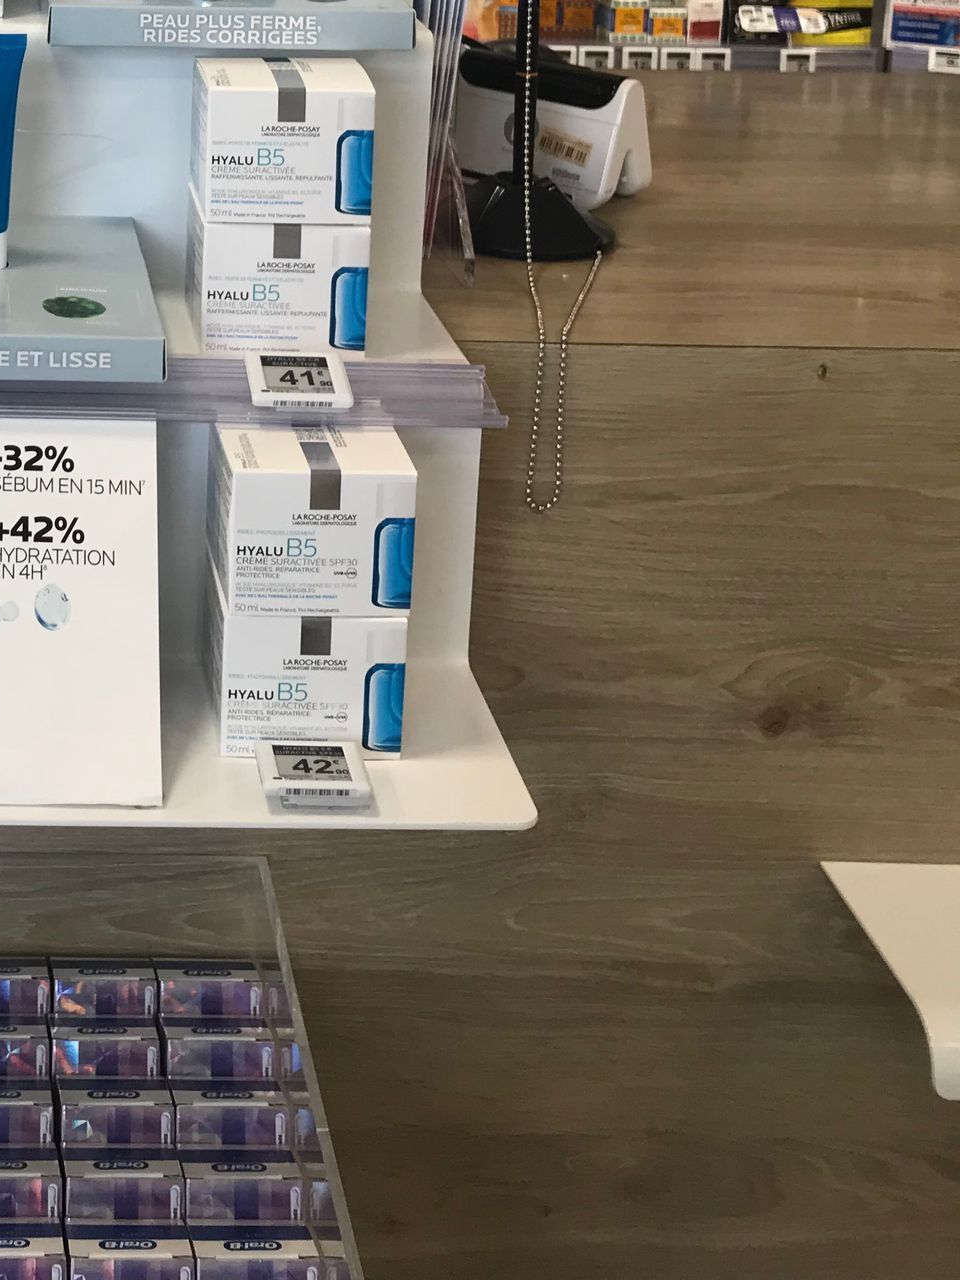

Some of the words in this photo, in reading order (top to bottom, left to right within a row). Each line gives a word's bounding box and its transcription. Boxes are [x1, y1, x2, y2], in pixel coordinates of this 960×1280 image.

[140, 13, 190, 28] PEAU
[195, 14, 246, 29] PLUS
[251, 15, 322, 33] FERME,
[143, 29, 201, 44] RIDES
[208, 26, 318, 45] CORRIGÉES
[211, 155, 254, 166] HYALU
[256, 148, 285, 166] B5
[207, 290, 249, 301] HYALU
[252, 283, 280, 302] B5
[16, 351, 44, 367] ET
[49, 352, 112, 368] LISSE
[58, 477, 83, 494] EN
[86, 478, 104, 495] 15
[292, 513, 302, 521] LA
[303, 513, 357, 521] ROCHE-POSAY
[236, 545, 284, 557] HYALU
[286, 537, 317, 557] B5
[235, 555, 268, 566] CRÈME
[270, 555, 328, 567] SURACTIVÉE
[330, 558, 358, 567] SPF30
[228, 689, 274, 701] HYALU
[277, 682, 308, 702] B5
